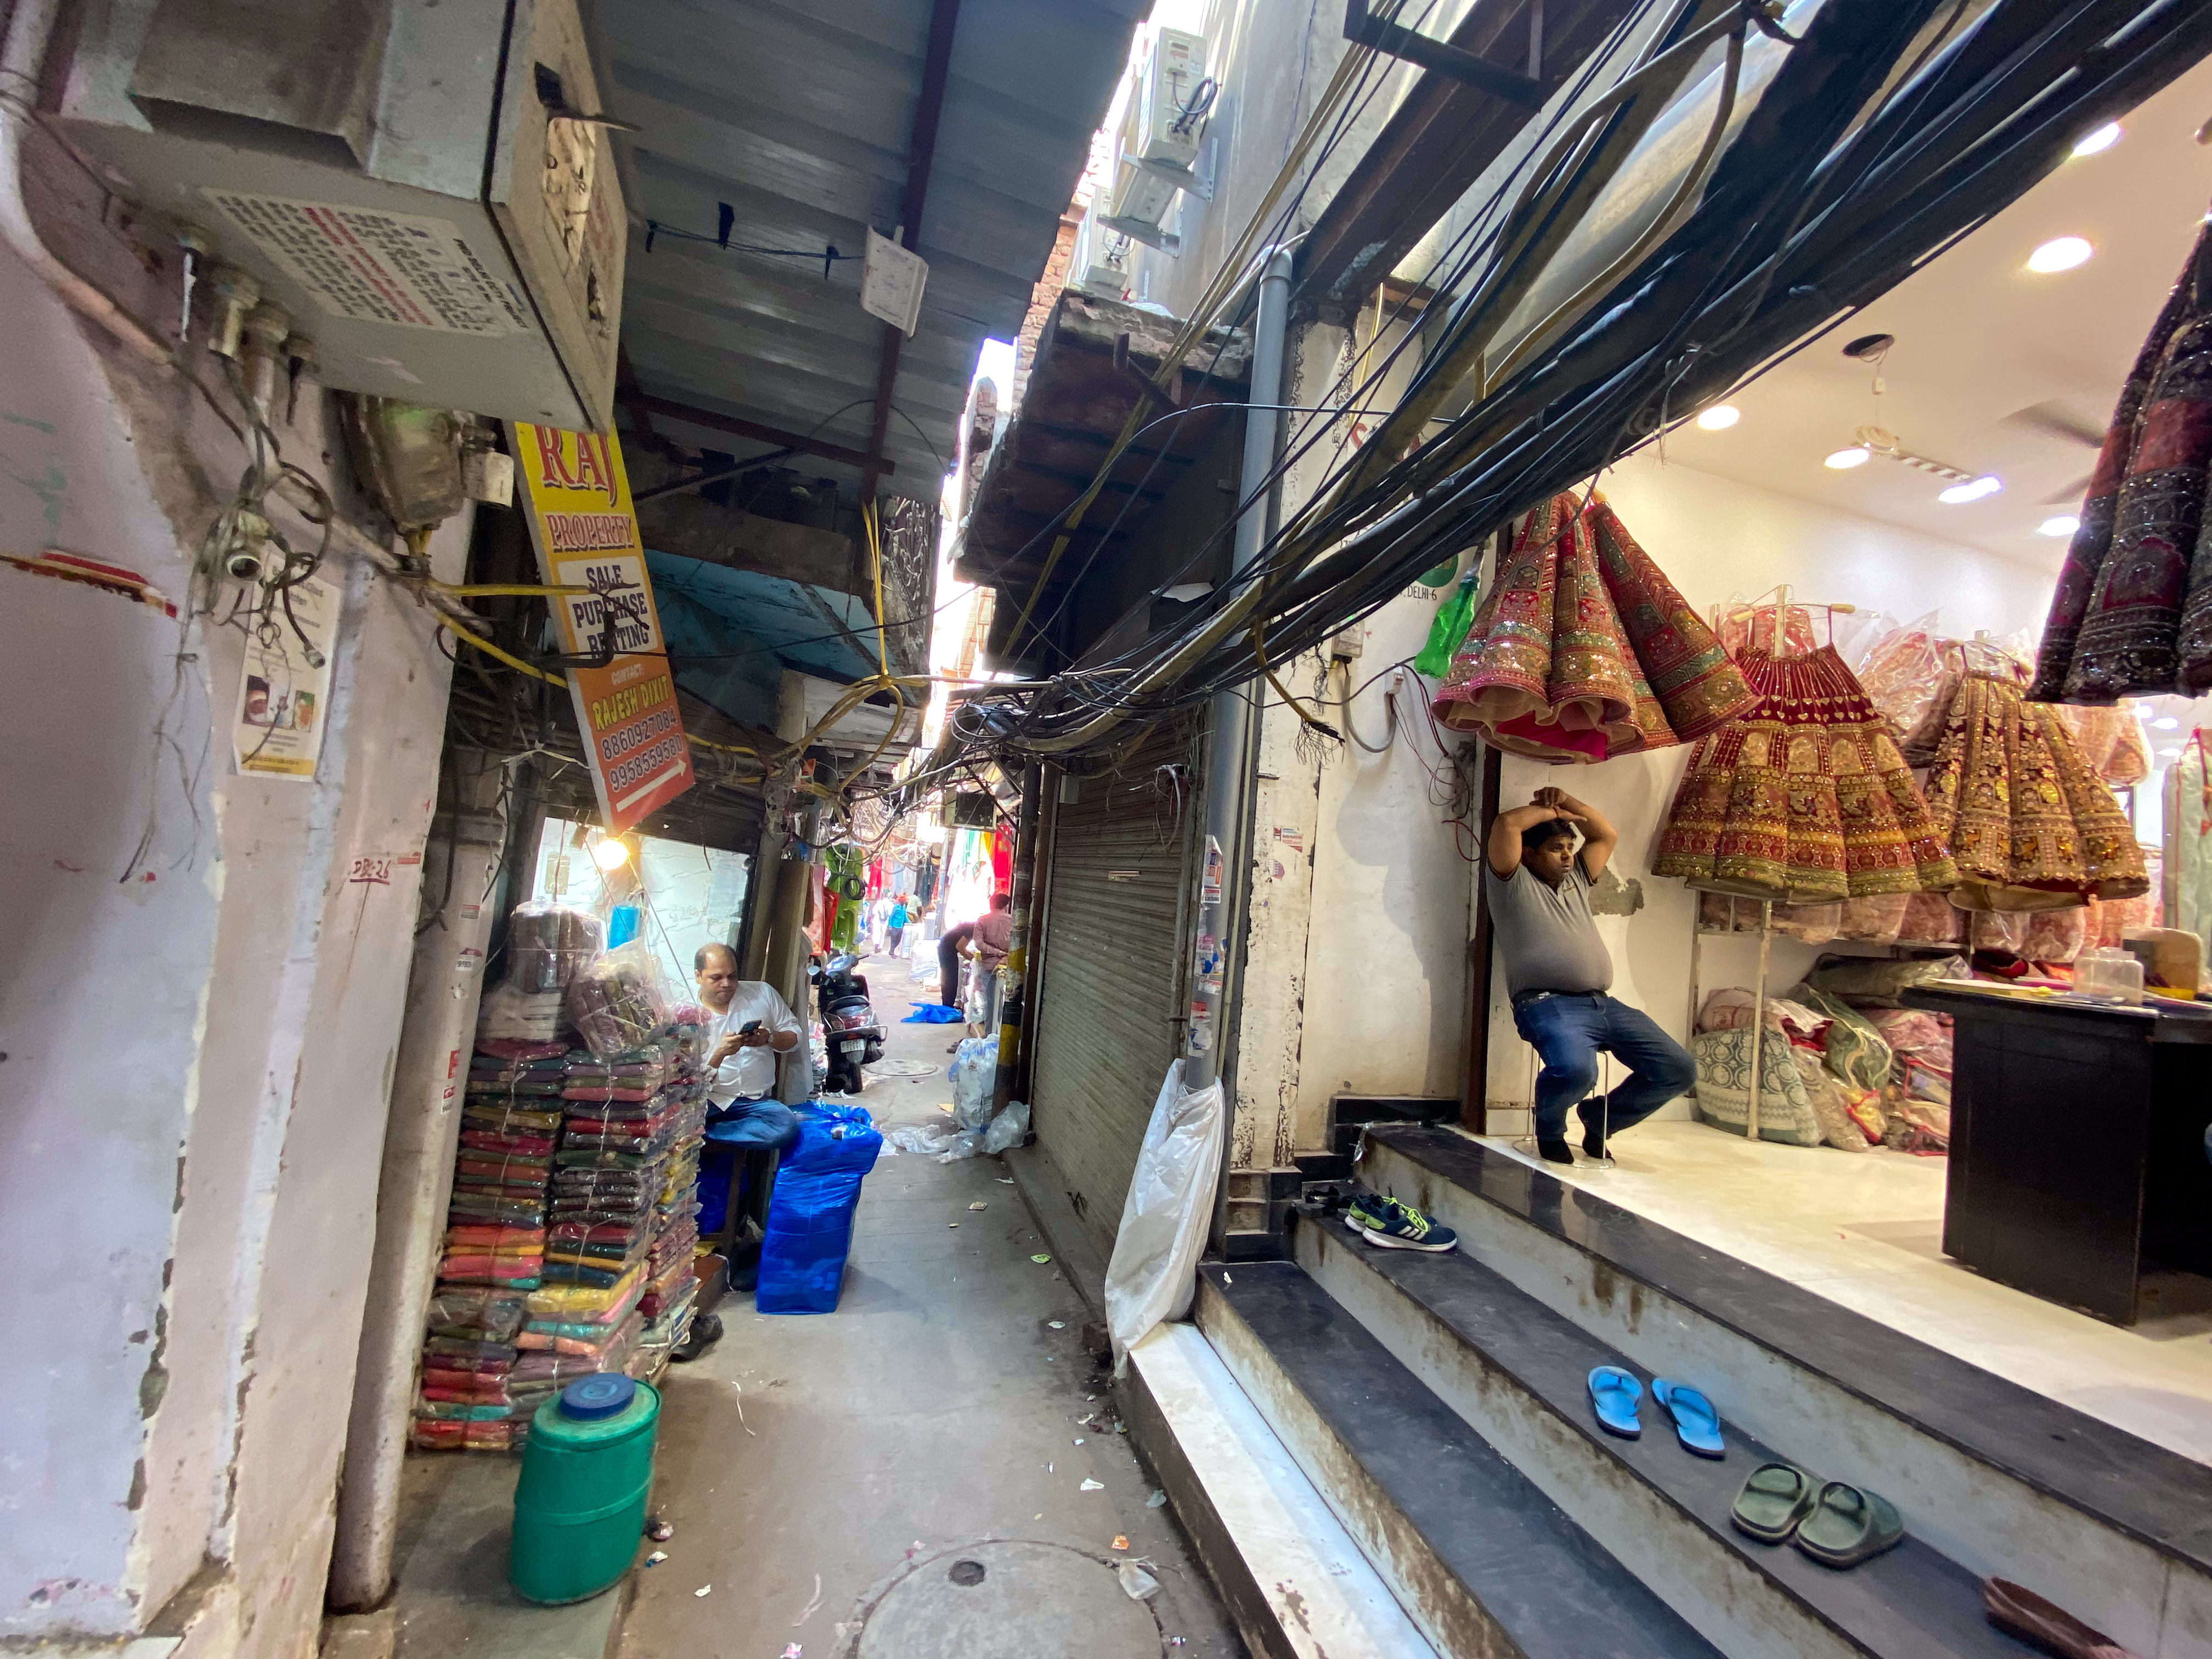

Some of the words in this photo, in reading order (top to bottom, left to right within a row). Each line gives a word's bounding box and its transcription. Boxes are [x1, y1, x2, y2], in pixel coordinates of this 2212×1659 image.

[534, 424, 617, 507] RAJ
[545, 513, 635, 552] PROPERTY
[586, 565, 625, 594] SALE
[1407, 585, 1437, 601] DELHI-6
[591, 692, 639, 731] RAJESH
[639, 674, 668, 709] DIXIT
[602, 706, 678, 760] 8860927084
[609, 733, 684, 792] 9958559580
